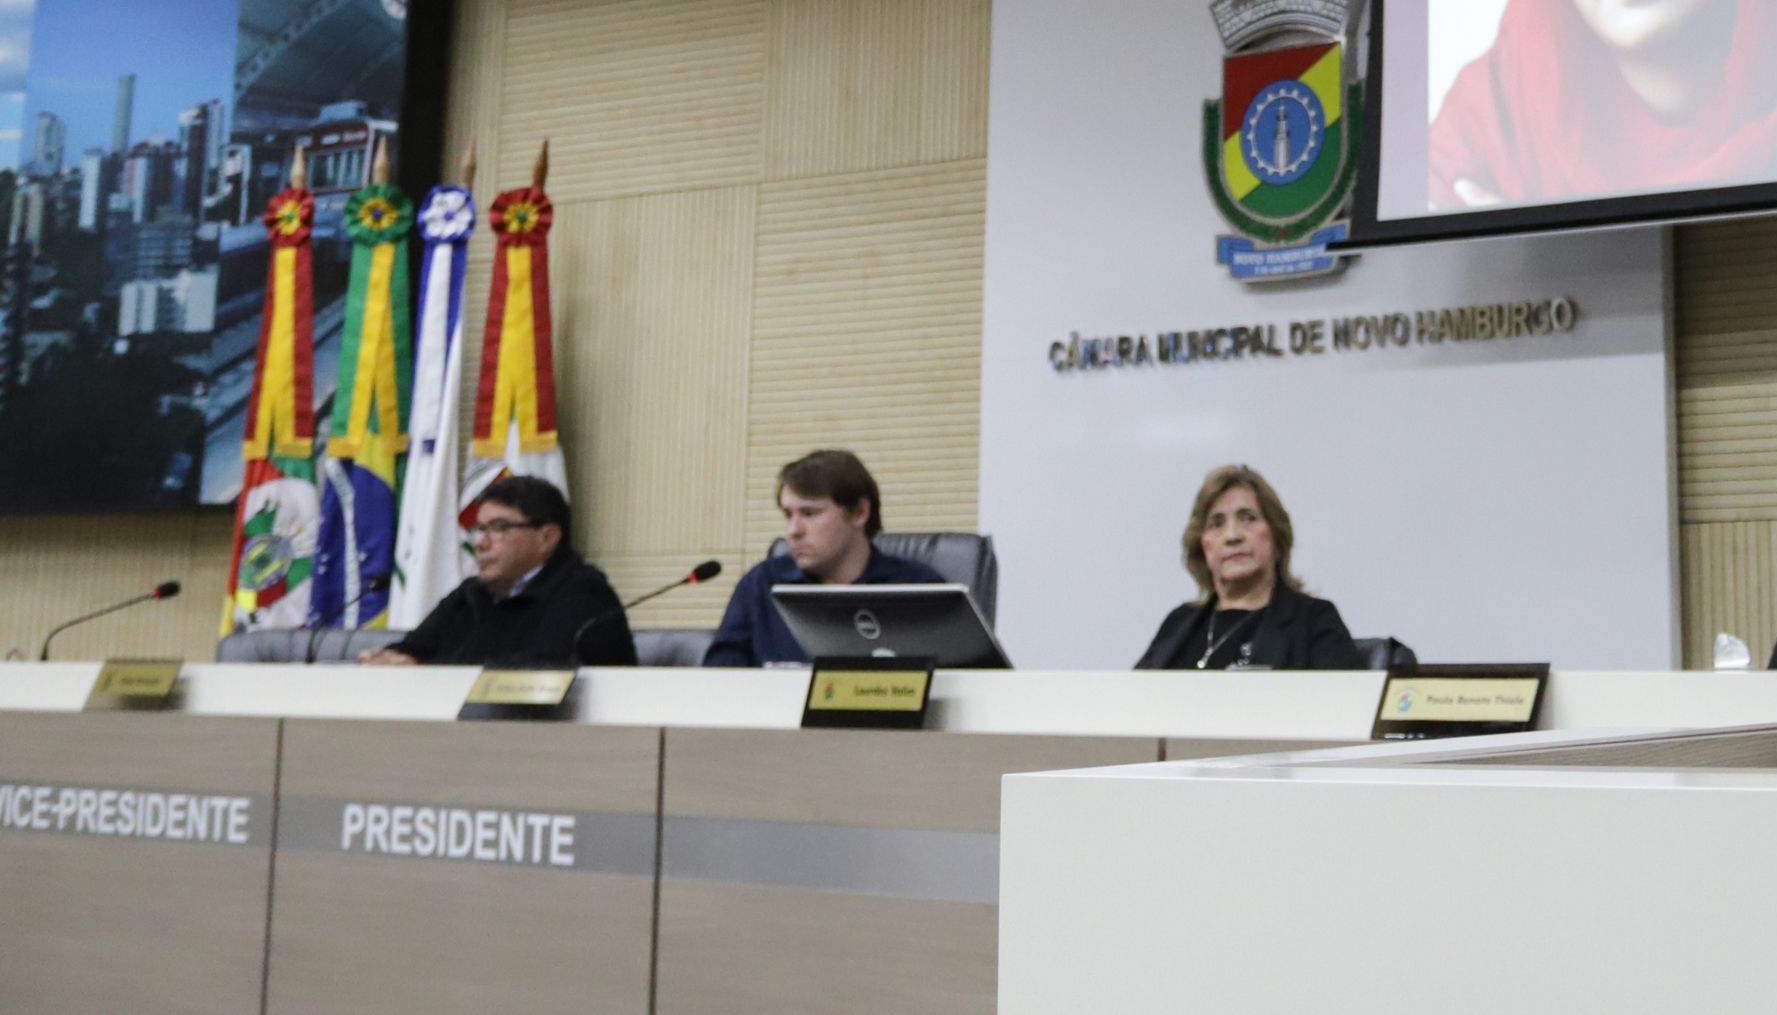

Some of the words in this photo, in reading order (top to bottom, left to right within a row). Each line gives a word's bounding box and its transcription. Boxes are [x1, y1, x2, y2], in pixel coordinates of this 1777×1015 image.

[1048, 330, 1153, 372] CÂMARA
[1157, 324, 1284, 364] MUNICIPAL
[1288, 319, 1326, 356] DE
[1332, 311, 1412, 351] NOVO
[1415, 296, 1577, 346] HAMBURGO
[341, 803, 577, 866] PRESIDENTE
